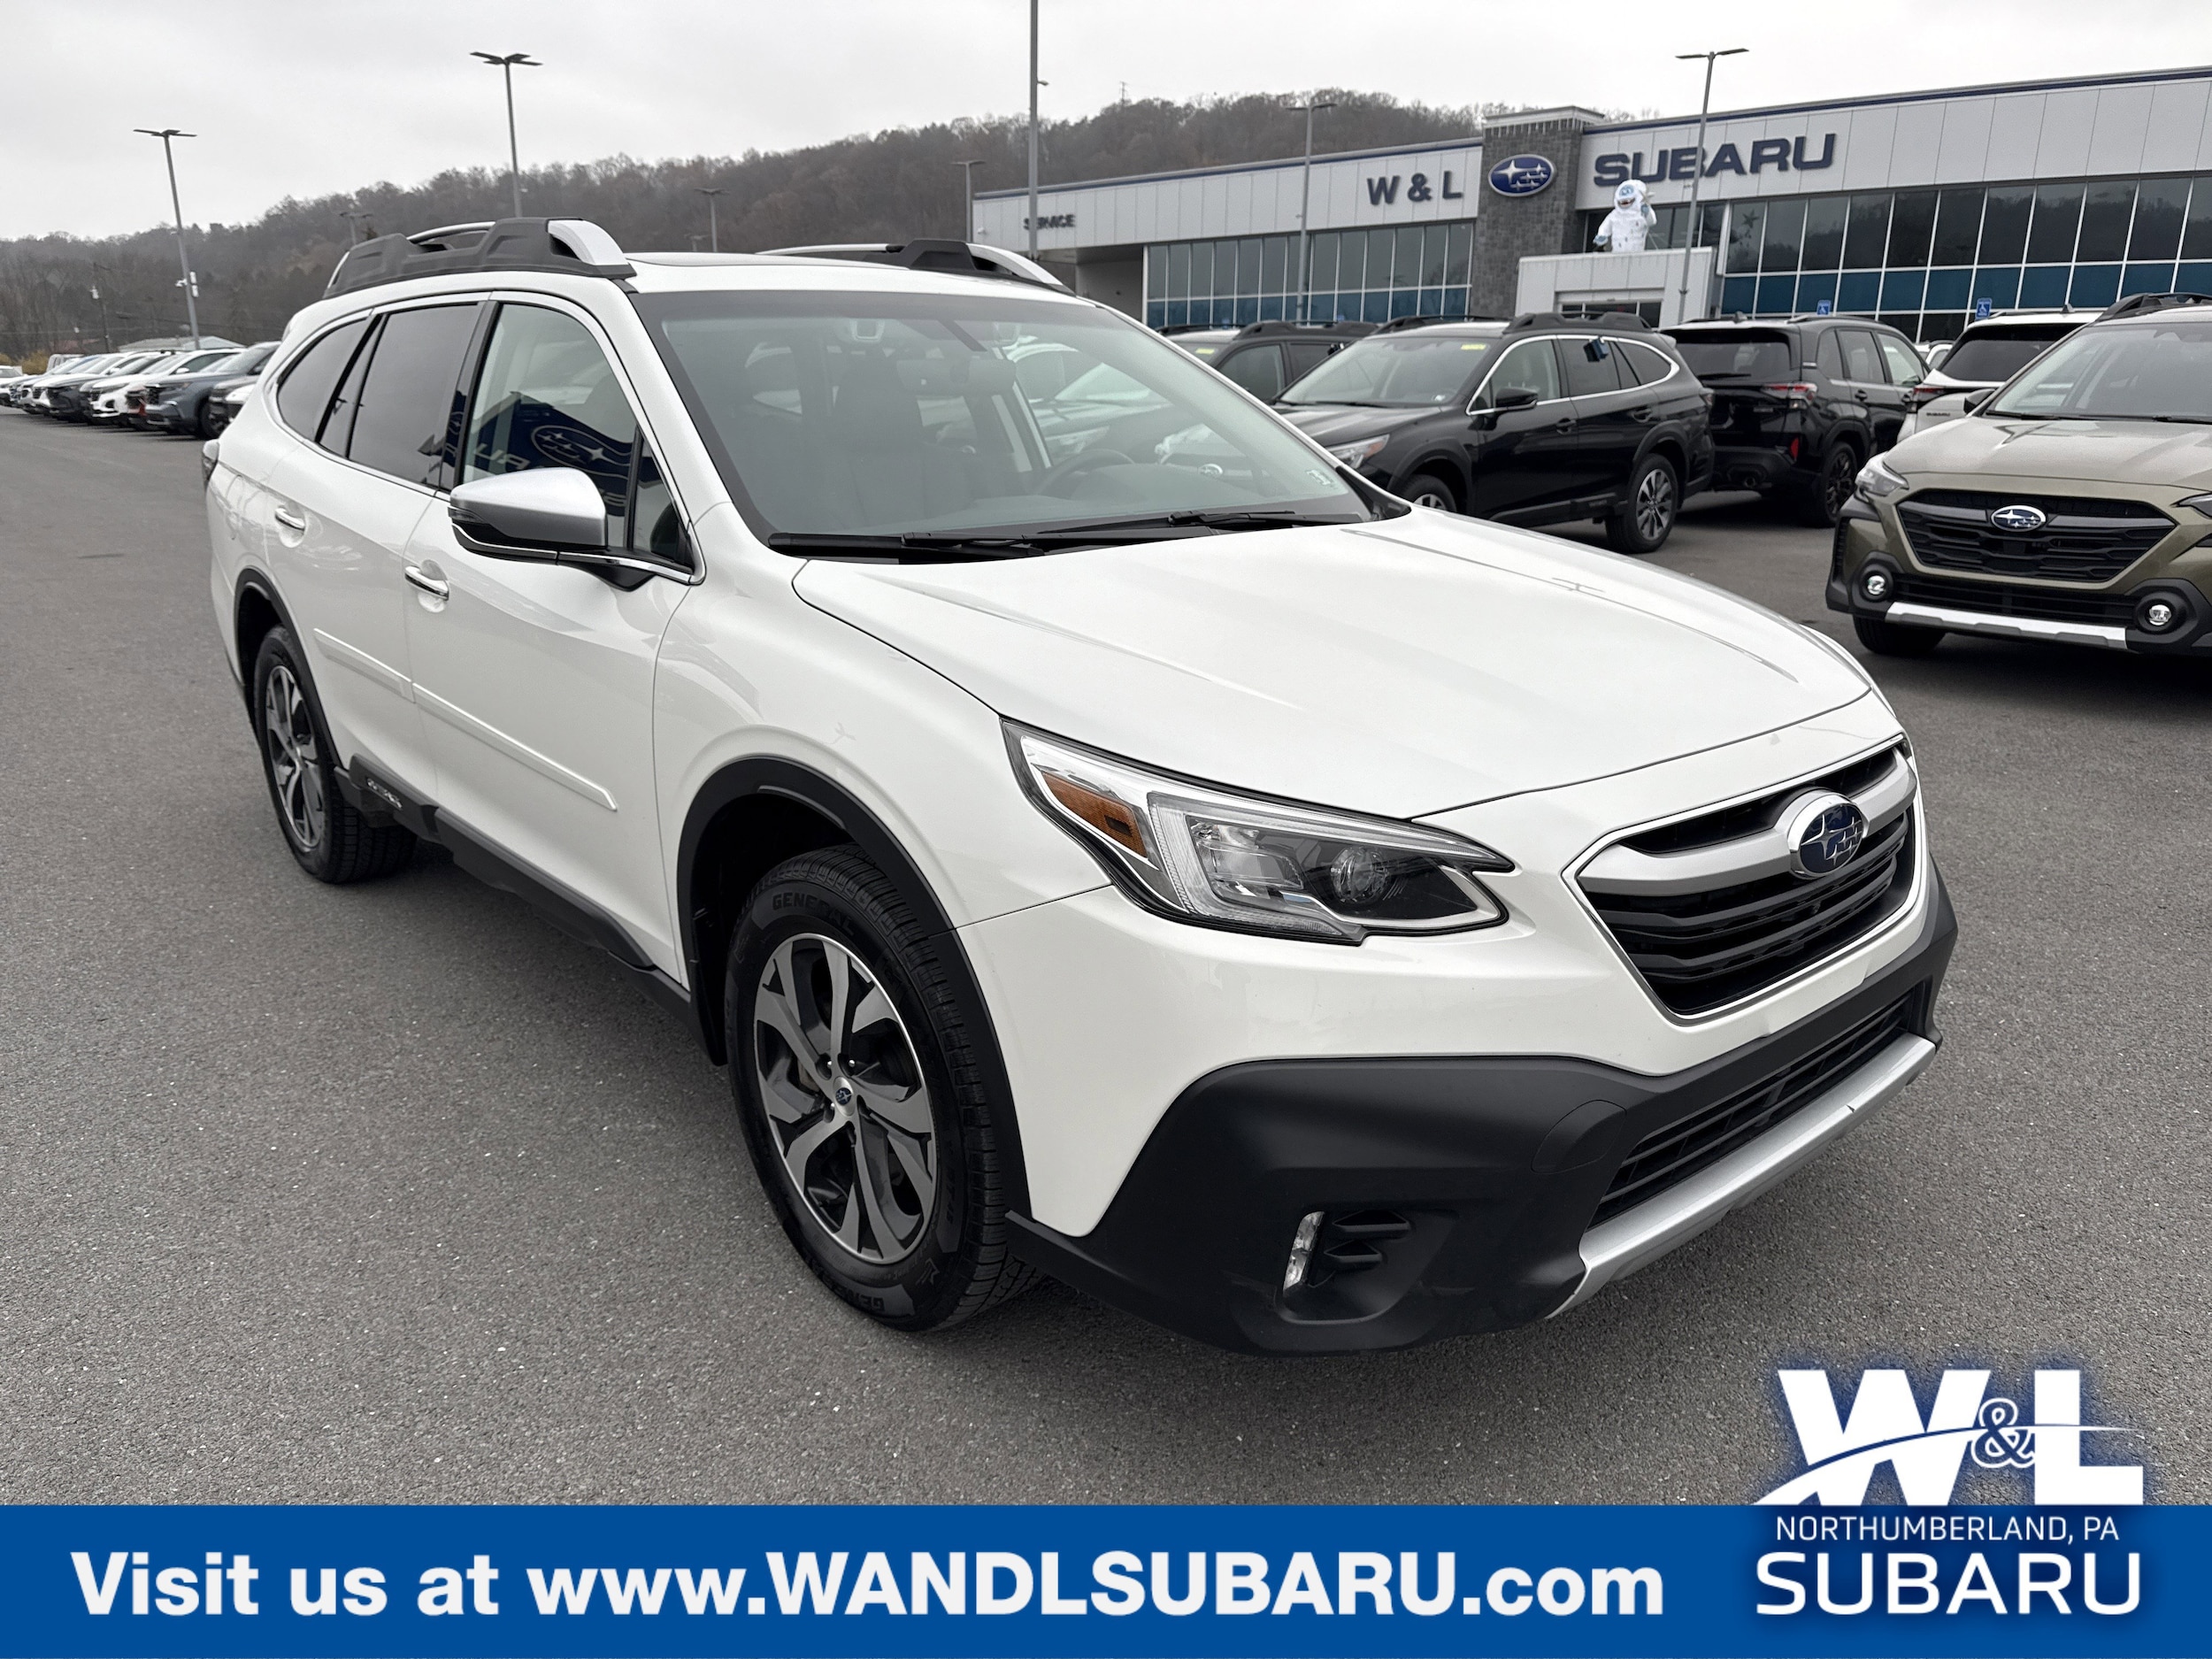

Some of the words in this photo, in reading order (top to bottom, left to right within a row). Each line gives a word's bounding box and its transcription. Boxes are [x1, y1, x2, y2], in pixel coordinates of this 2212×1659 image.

[1594, 133, 1837, 188] SUBARU
[1366, 175, 1401, 206] W
[1407, 173, 1432, 203] &
[1442, 170, 1464, 200] L
[772, 892, 856, 937] GENERAL
